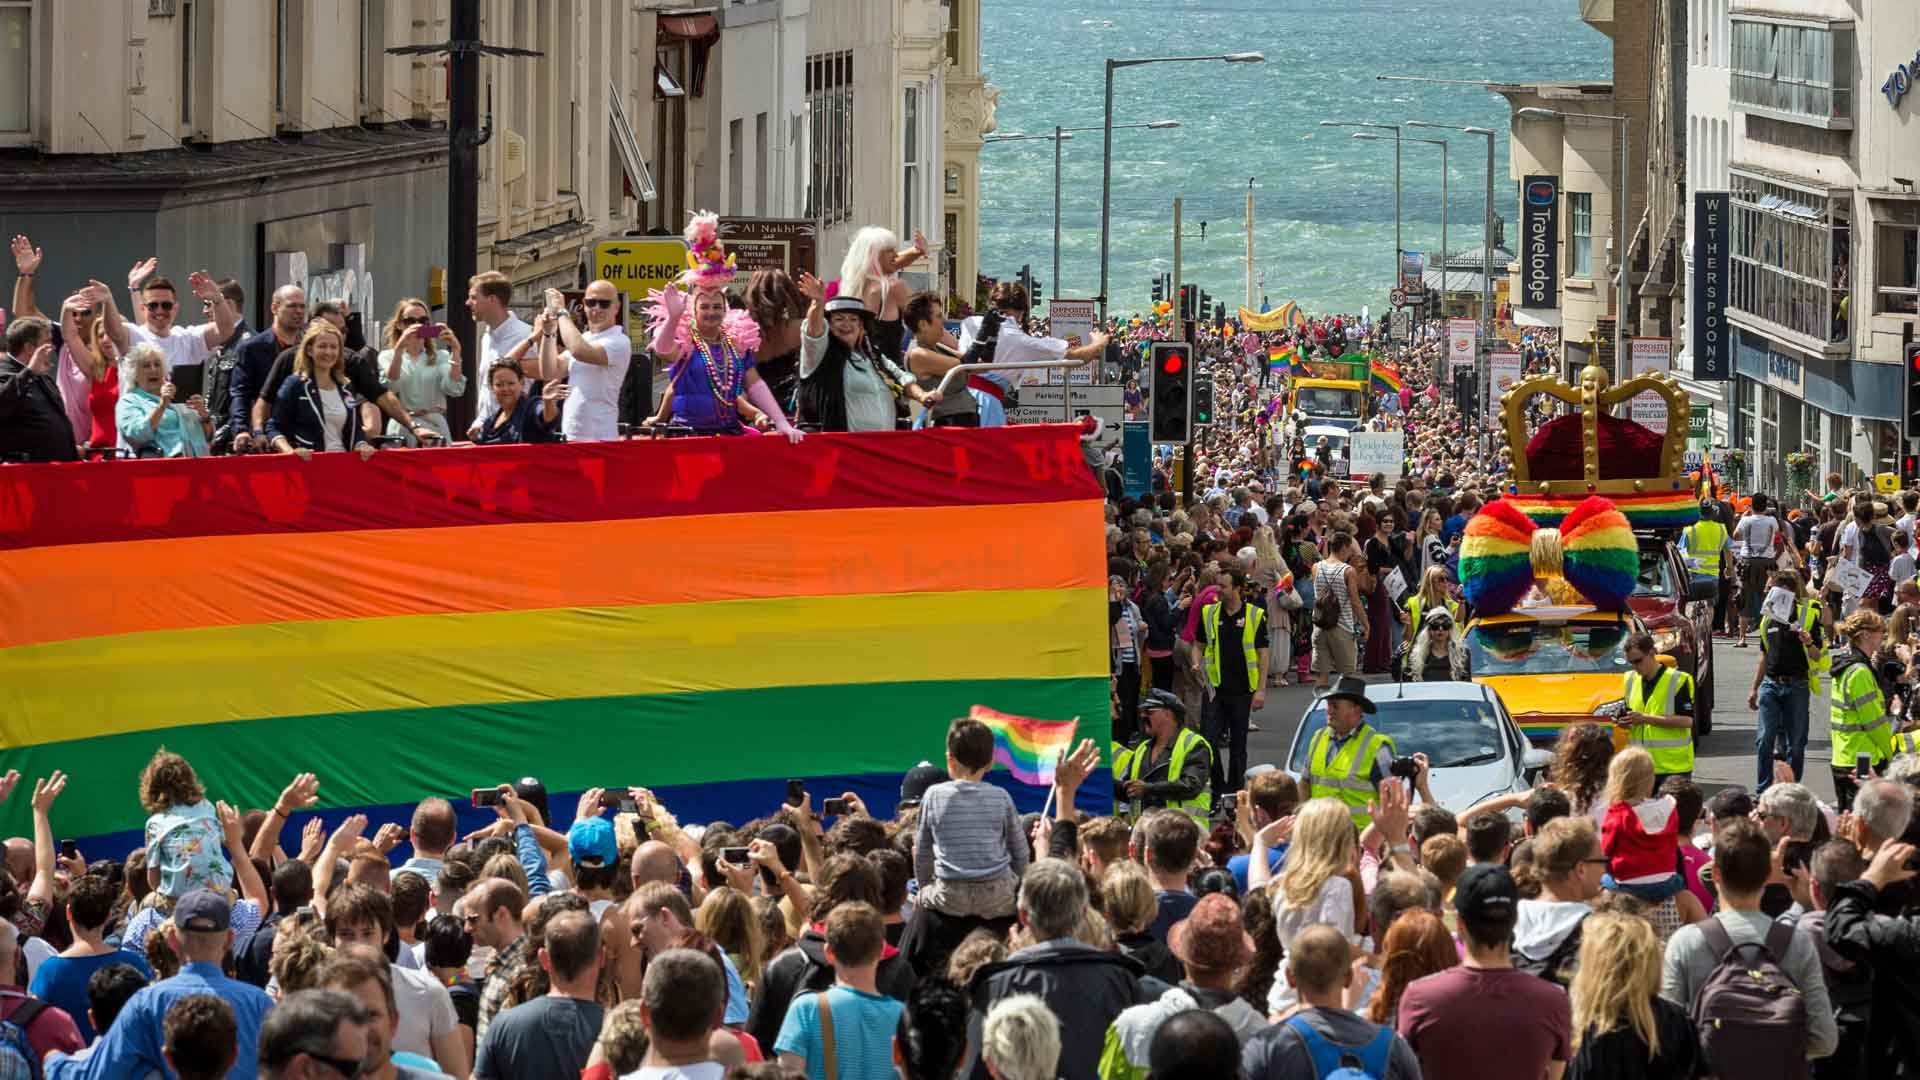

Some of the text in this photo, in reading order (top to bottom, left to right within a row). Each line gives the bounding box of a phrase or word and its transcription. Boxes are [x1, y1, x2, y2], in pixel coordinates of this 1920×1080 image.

[742, 223, 795, 233] Al Nakhl
[1528, 208, 1551, 302] Travelodge
[627, 264, 680, 280] LICENCE
[1705, 199, 1720, 372] WETHERSPOONS
[1392, 294, 1404, 302] 30
[1035, 391, 1064, 400] Parking
